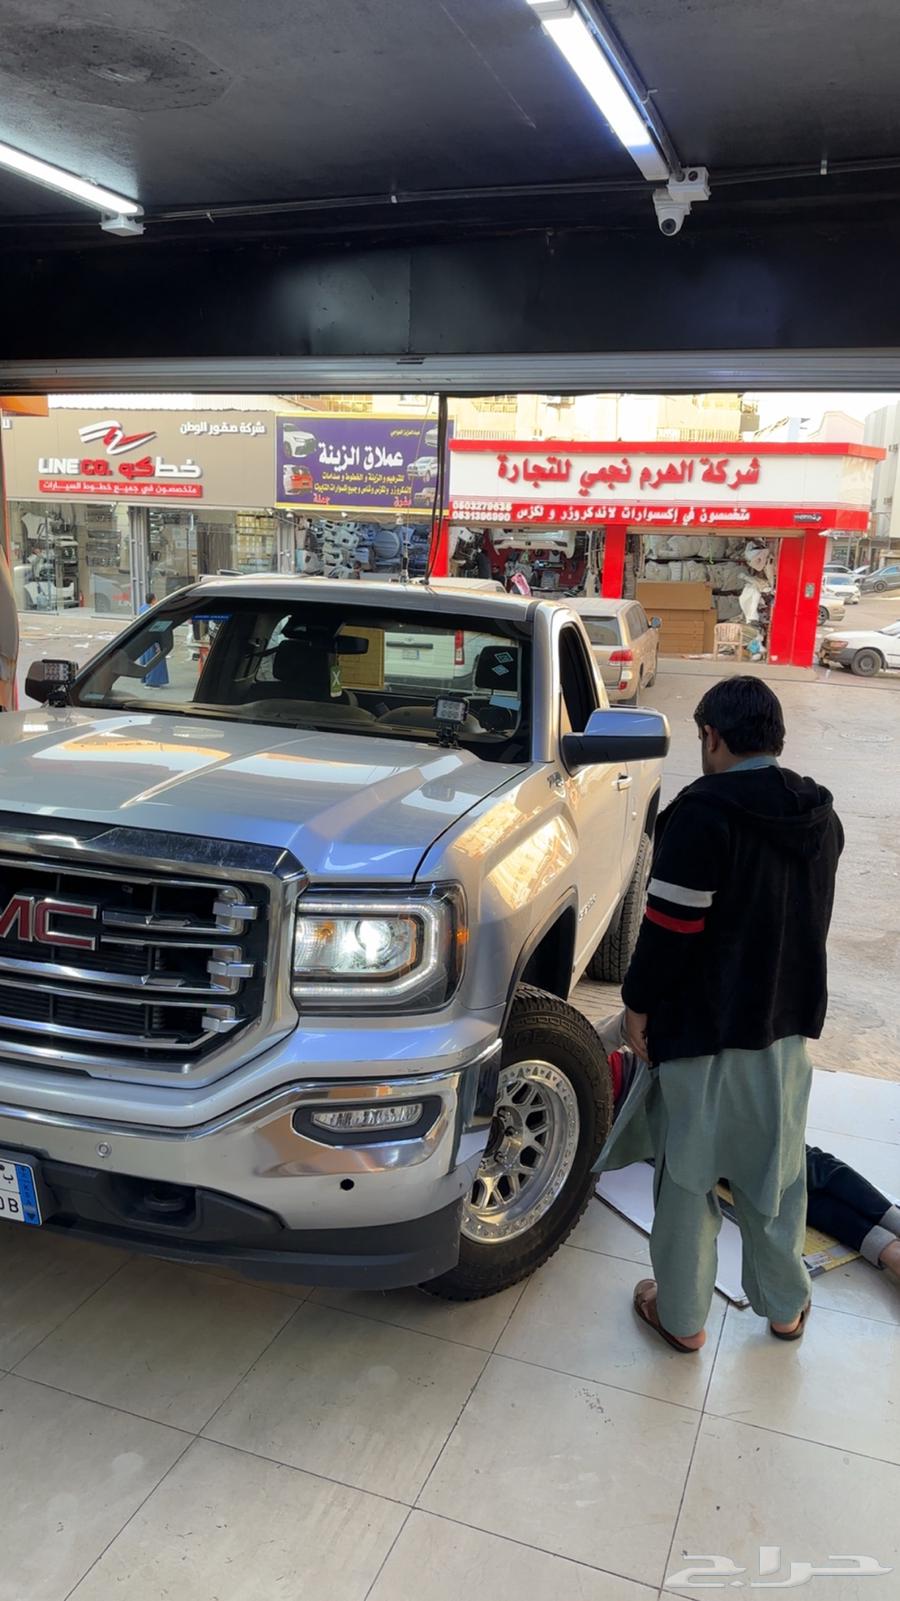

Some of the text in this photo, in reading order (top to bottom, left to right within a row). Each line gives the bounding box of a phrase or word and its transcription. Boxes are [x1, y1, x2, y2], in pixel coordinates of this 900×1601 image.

[180, 421, 265, 436] شركة صقور الوطن
[318, 442, 403, 472] عملاق الزينة
[38, 457, 79, 475] LINE
[497, 455, 760, 497] شركة الهرم نجمي للتجارة
[42, 480, 197, 495] متخصصون في جميع خطوط السيارات
[549, 508, 556, 519] و
[682, 506, 695, 526] في
[699, 507, 750, 522] متخصصون
